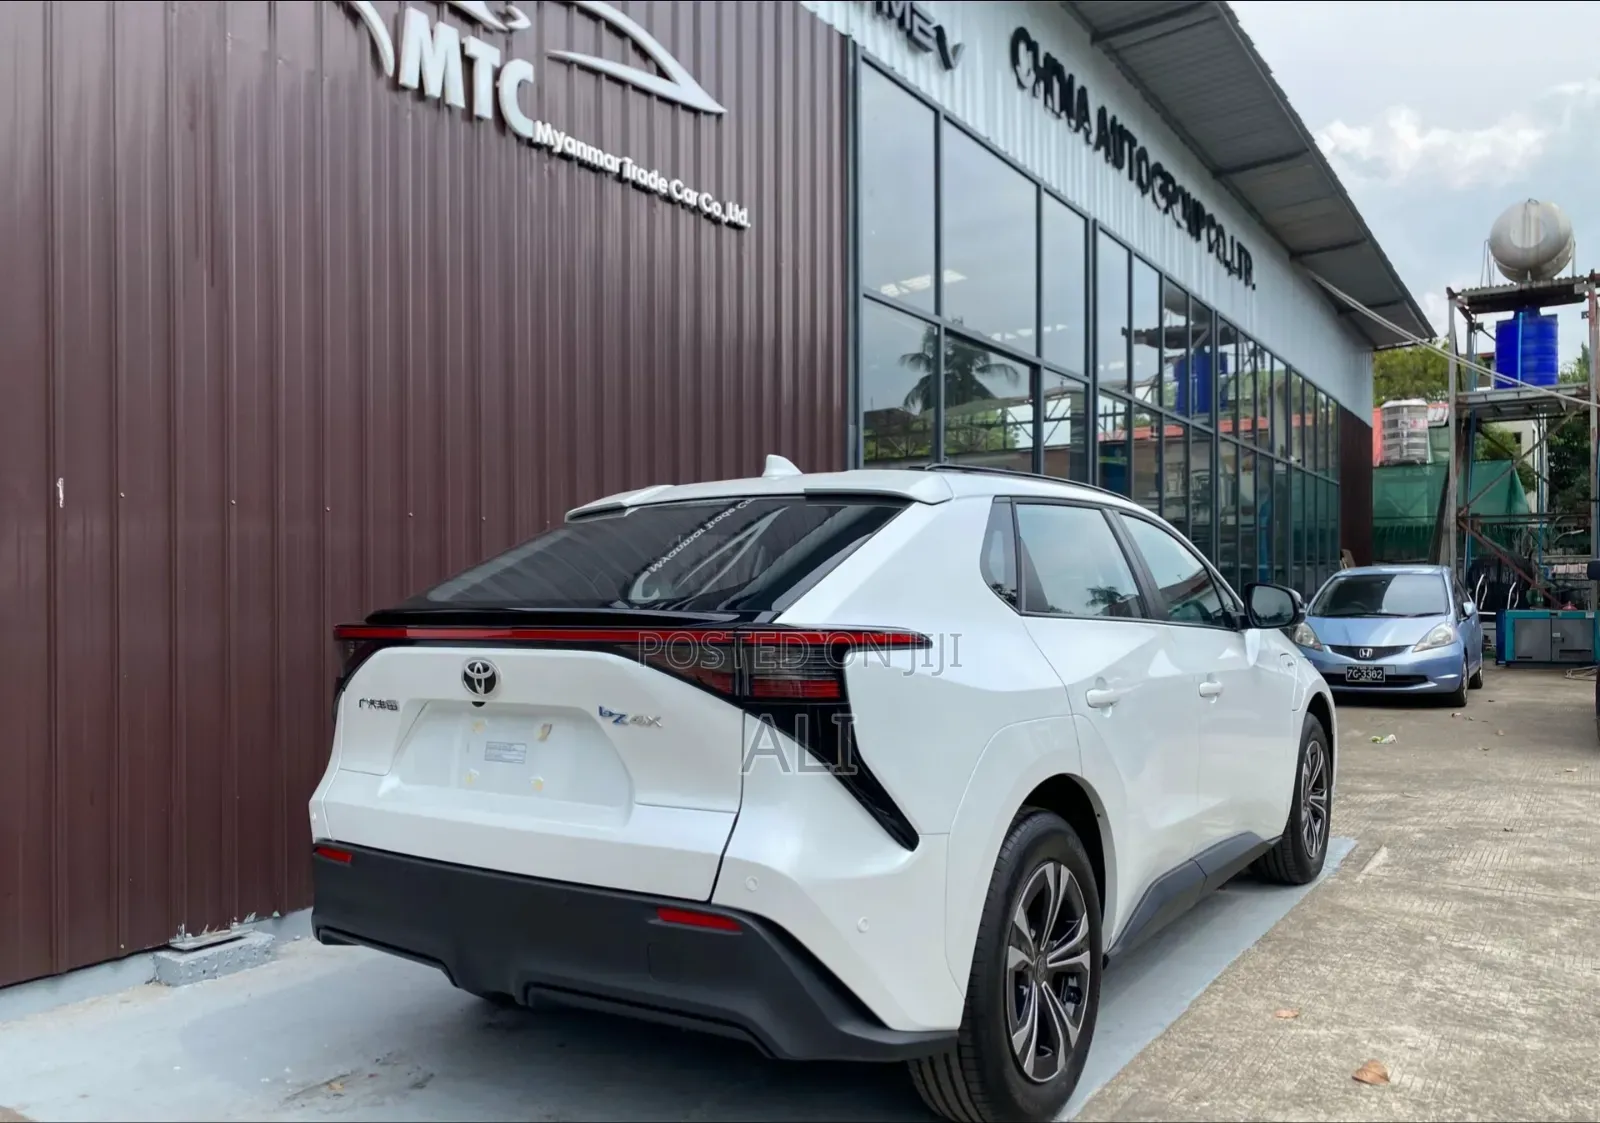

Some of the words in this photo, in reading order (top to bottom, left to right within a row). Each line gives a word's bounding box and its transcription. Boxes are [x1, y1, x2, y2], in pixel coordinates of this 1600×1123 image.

[399, 6, 534, 138] MTC
[1010, 26, 1092, 145] CHINA
[532, 120, 621, 173] Myanmar
[621, 156, 669, 194] Trade
[668, 179, 699, 206] Car
